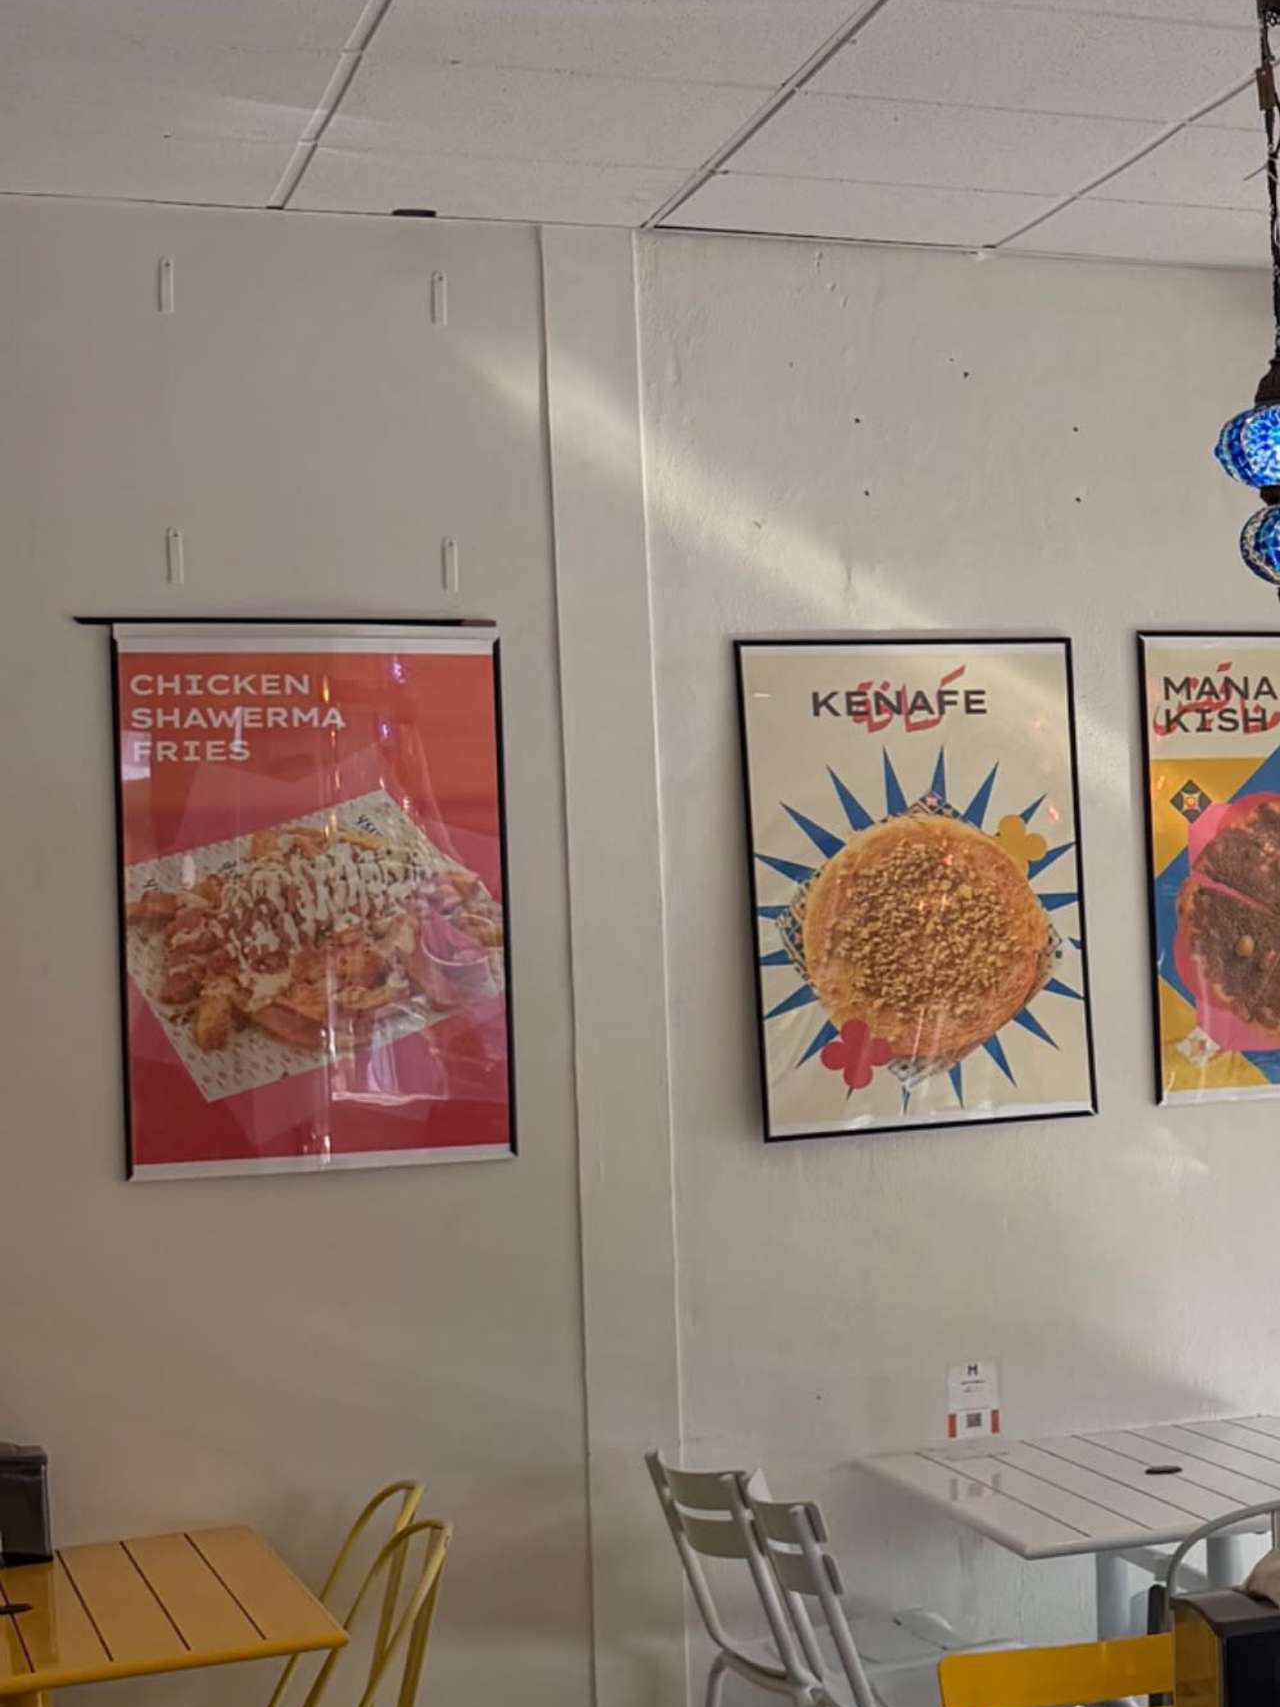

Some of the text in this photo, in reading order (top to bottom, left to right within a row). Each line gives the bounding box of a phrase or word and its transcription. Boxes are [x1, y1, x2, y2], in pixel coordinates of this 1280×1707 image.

[129, 673, 311, 696] CHICKEN
[1162, 675, 1279, 701] MANA
[811, 689, 988, 717] KENAFE
[131, 706, 347, 730] SHAWERMA
[1164, 707, 1268, 734] KISH
[133, 740, 251, 763] FRIES
